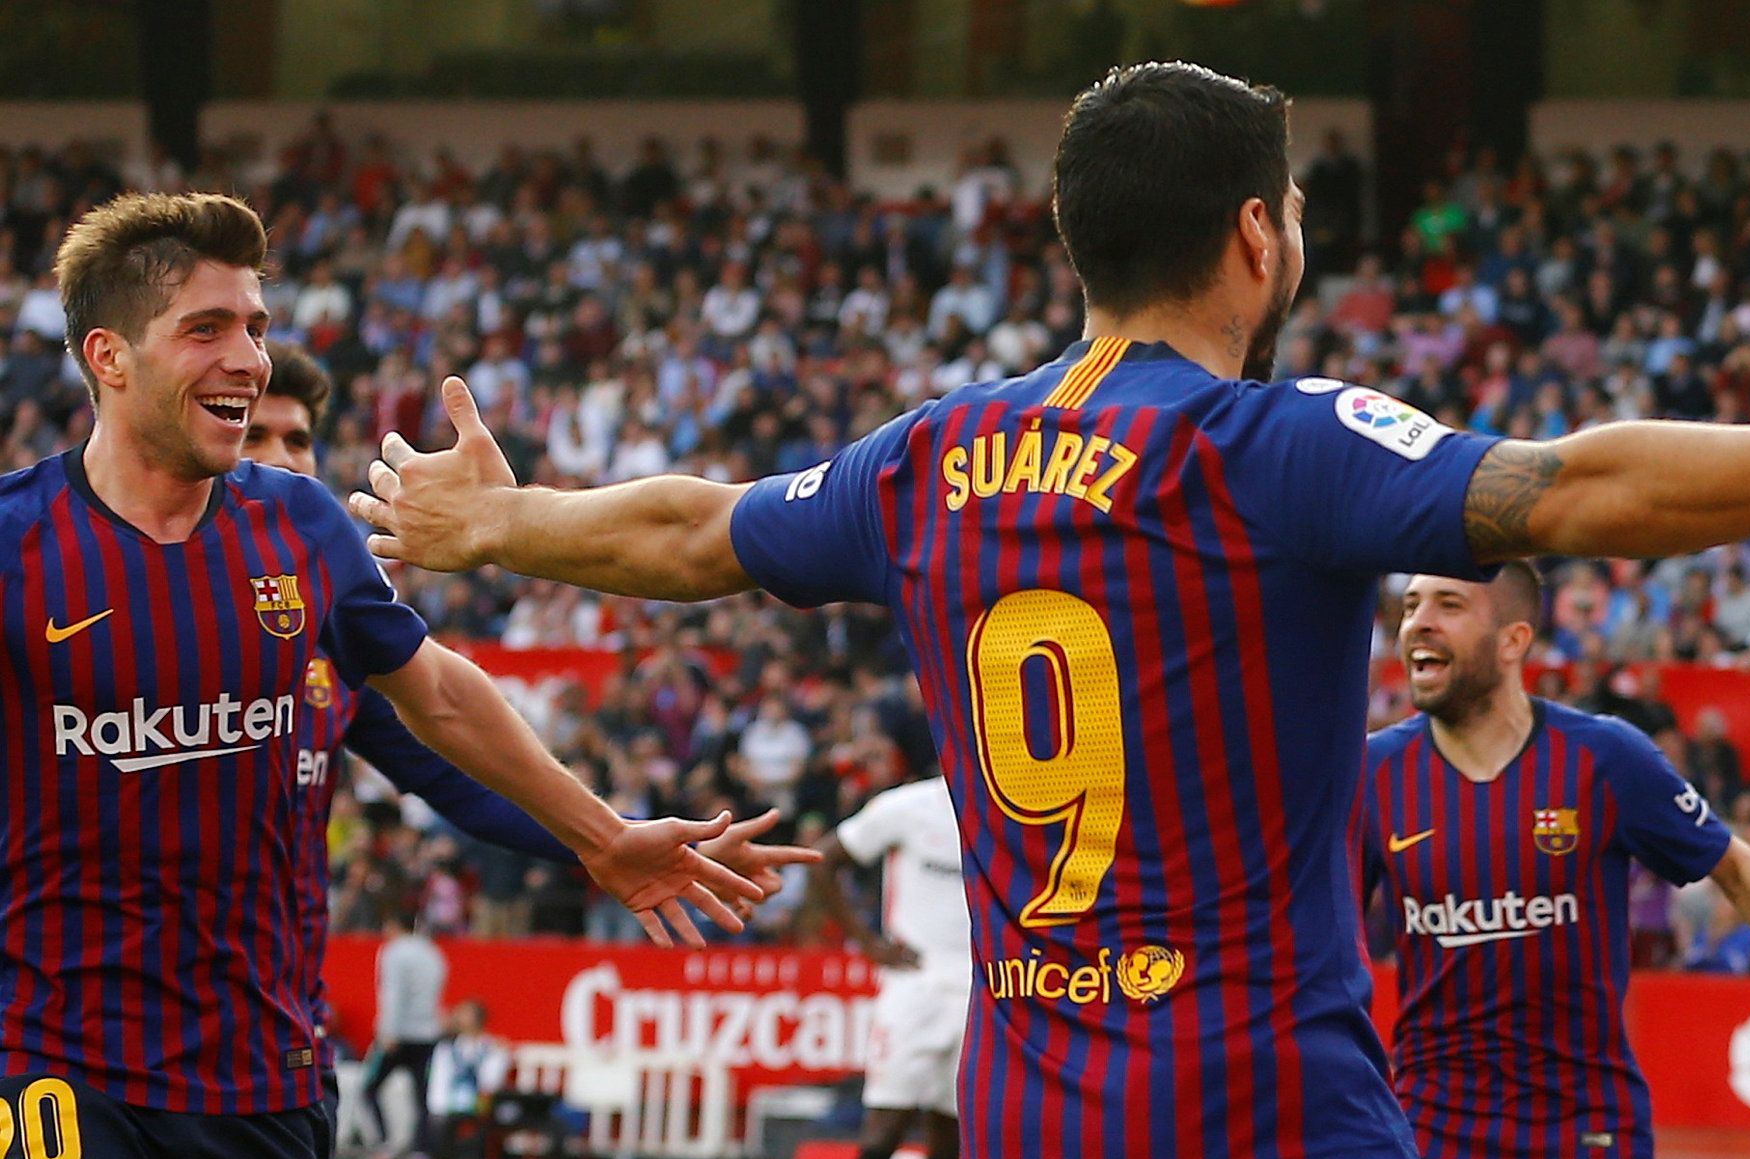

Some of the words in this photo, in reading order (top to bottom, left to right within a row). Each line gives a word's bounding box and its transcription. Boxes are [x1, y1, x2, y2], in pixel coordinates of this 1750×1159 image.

[942, 417, 1138, 514] SUÁREZ
[53, 693, 294, 756] Rakuten
[967, 588, 1125, 928] 9
[1402, 891, 1579, 935] Rakuten
[988, 947, 1111, 1004] unicef
